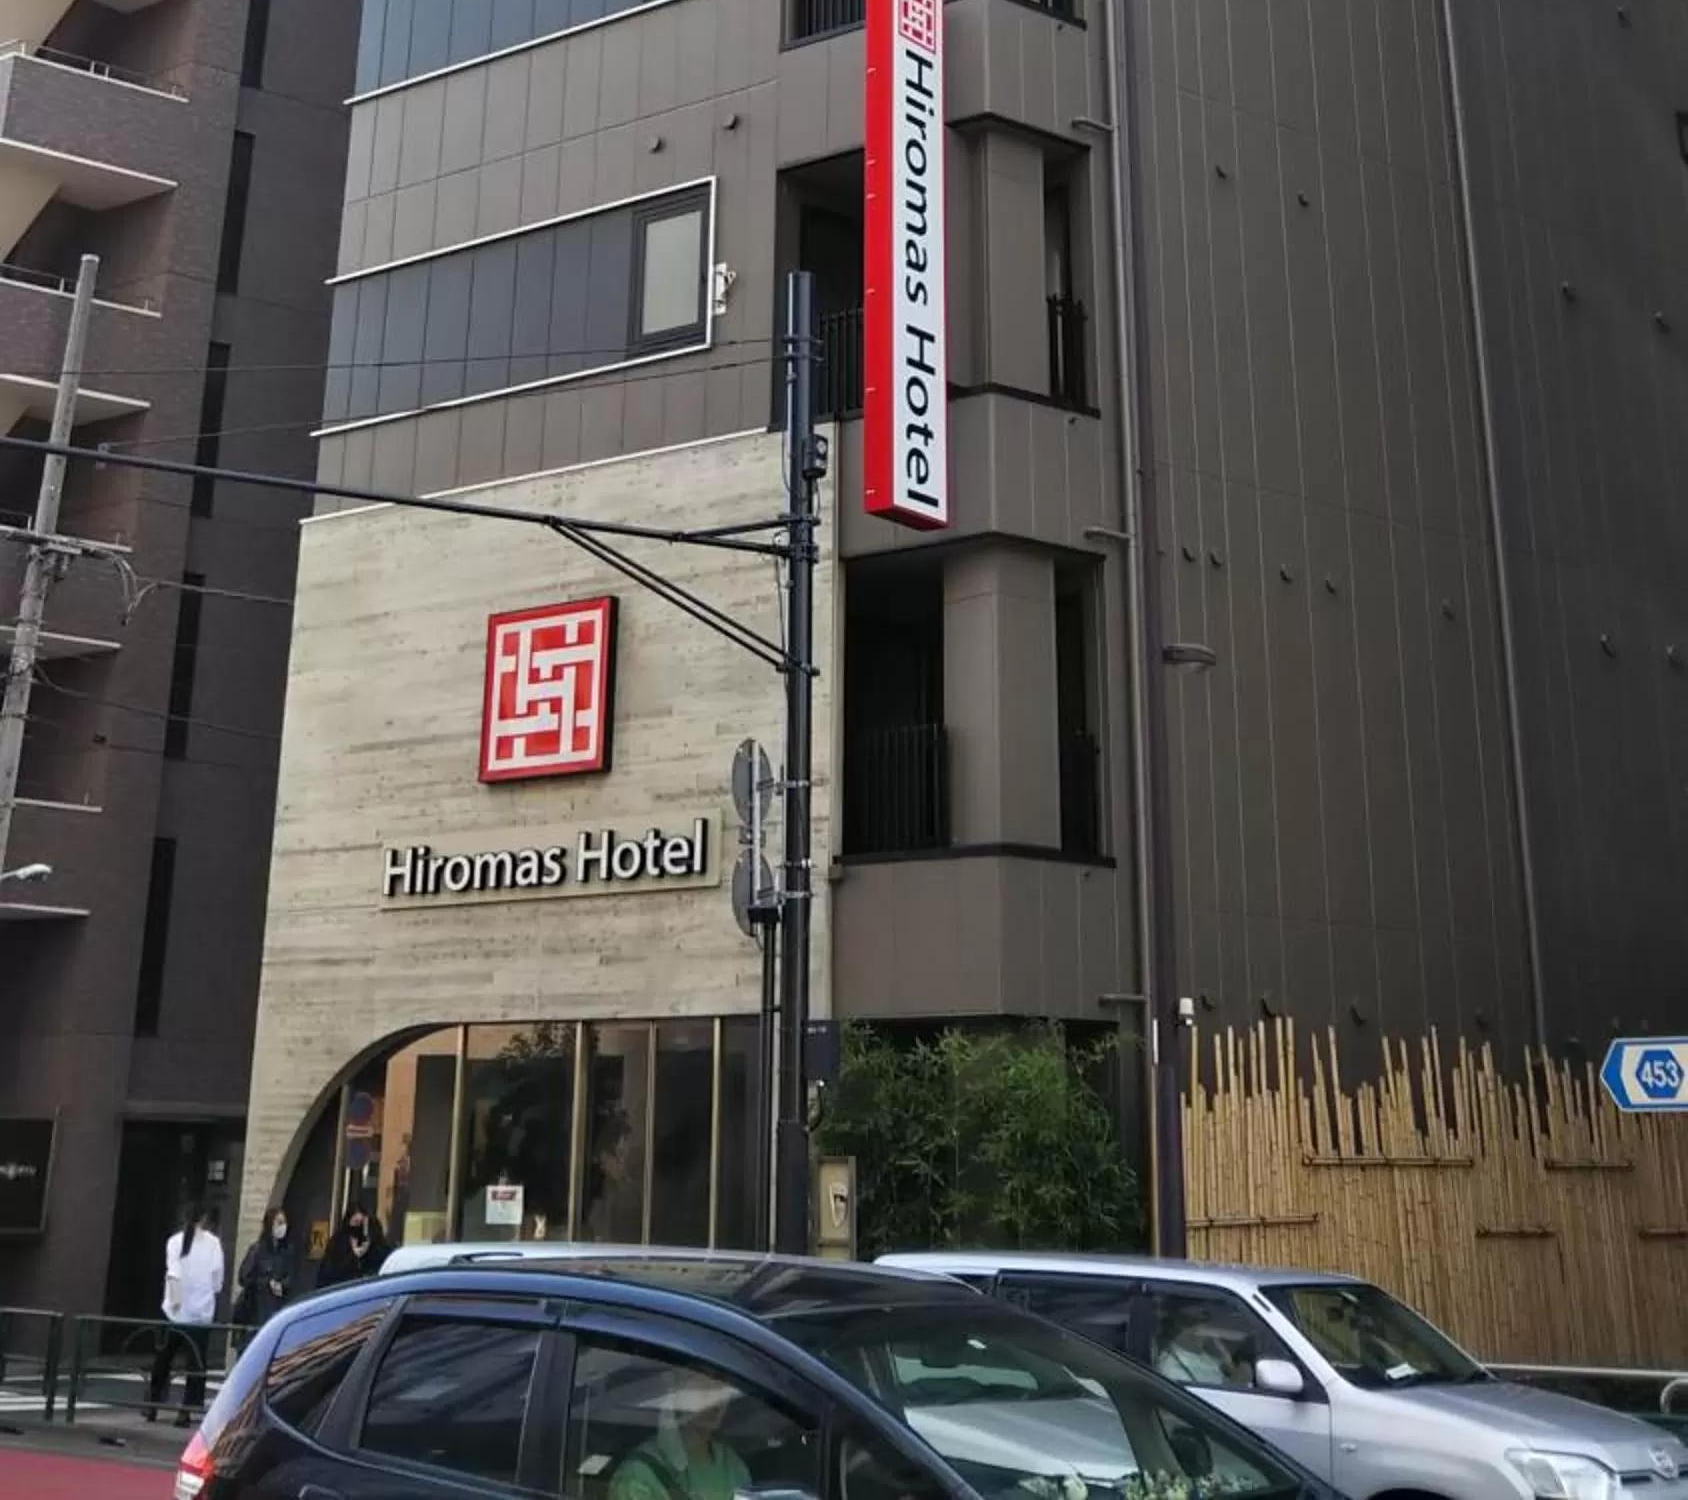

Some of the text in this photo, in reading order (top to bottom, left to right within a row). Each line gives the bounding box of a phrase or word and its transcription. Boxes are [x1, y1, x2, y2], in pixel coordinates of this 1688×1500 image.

[905, 49, 939, 508] Hiromas Hotel
[383, 818, 708, 896] Hiromas Hotel
[1641, 1060, 1679, 1088] 453
